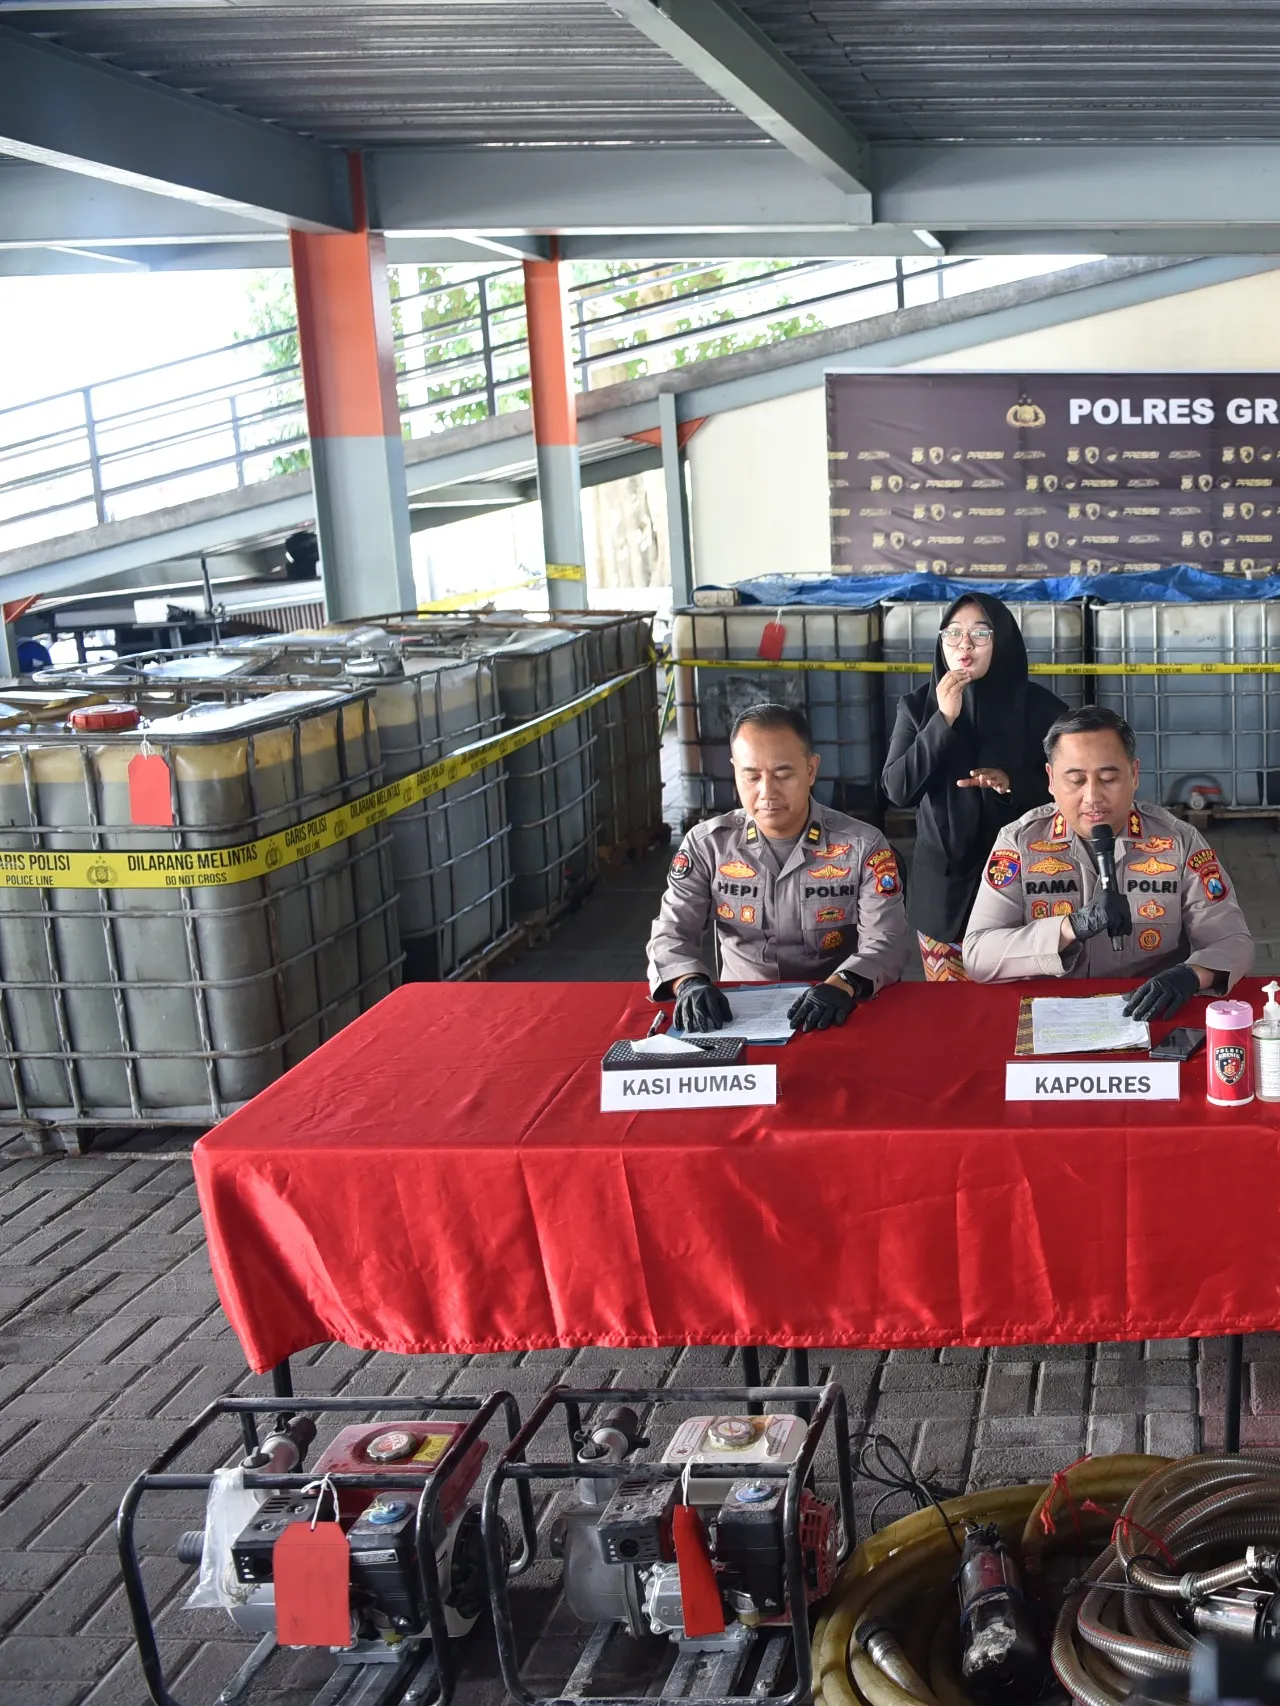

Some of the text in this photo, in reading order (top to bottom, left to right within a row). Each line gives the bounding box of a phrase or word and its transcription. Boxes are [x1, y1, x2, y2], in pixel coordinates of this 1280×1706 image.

[1070, 398, 1215, 425] POLRES
[350, 784, 400, 819] DILARANG MELINTAS
[285, 816, 327, 847] GARIS POLISI
[296, 839, 320, 858] POLICE LINE
[0, 855, 70, 871] ARIS POLISI
[128, 845, 258, 871] DILARANG MELINTAS
[1190, 851, 1213, 866] POLRES
[6, 875, 53, 886] POLICE LINE
[165, 872, 227, 886] DO NOT CROSS
[1026, 880, 1078, 895] RAMA
[1127, 880, 1177, 894] POLRI
[718, 881, 758, 898] HEPI
[805, 885, 855, 898] POLRI
[623, 1074, 756, 1096] KASI HUMAS
[1036, 1076, 1151, 1094] KAPOLRES
